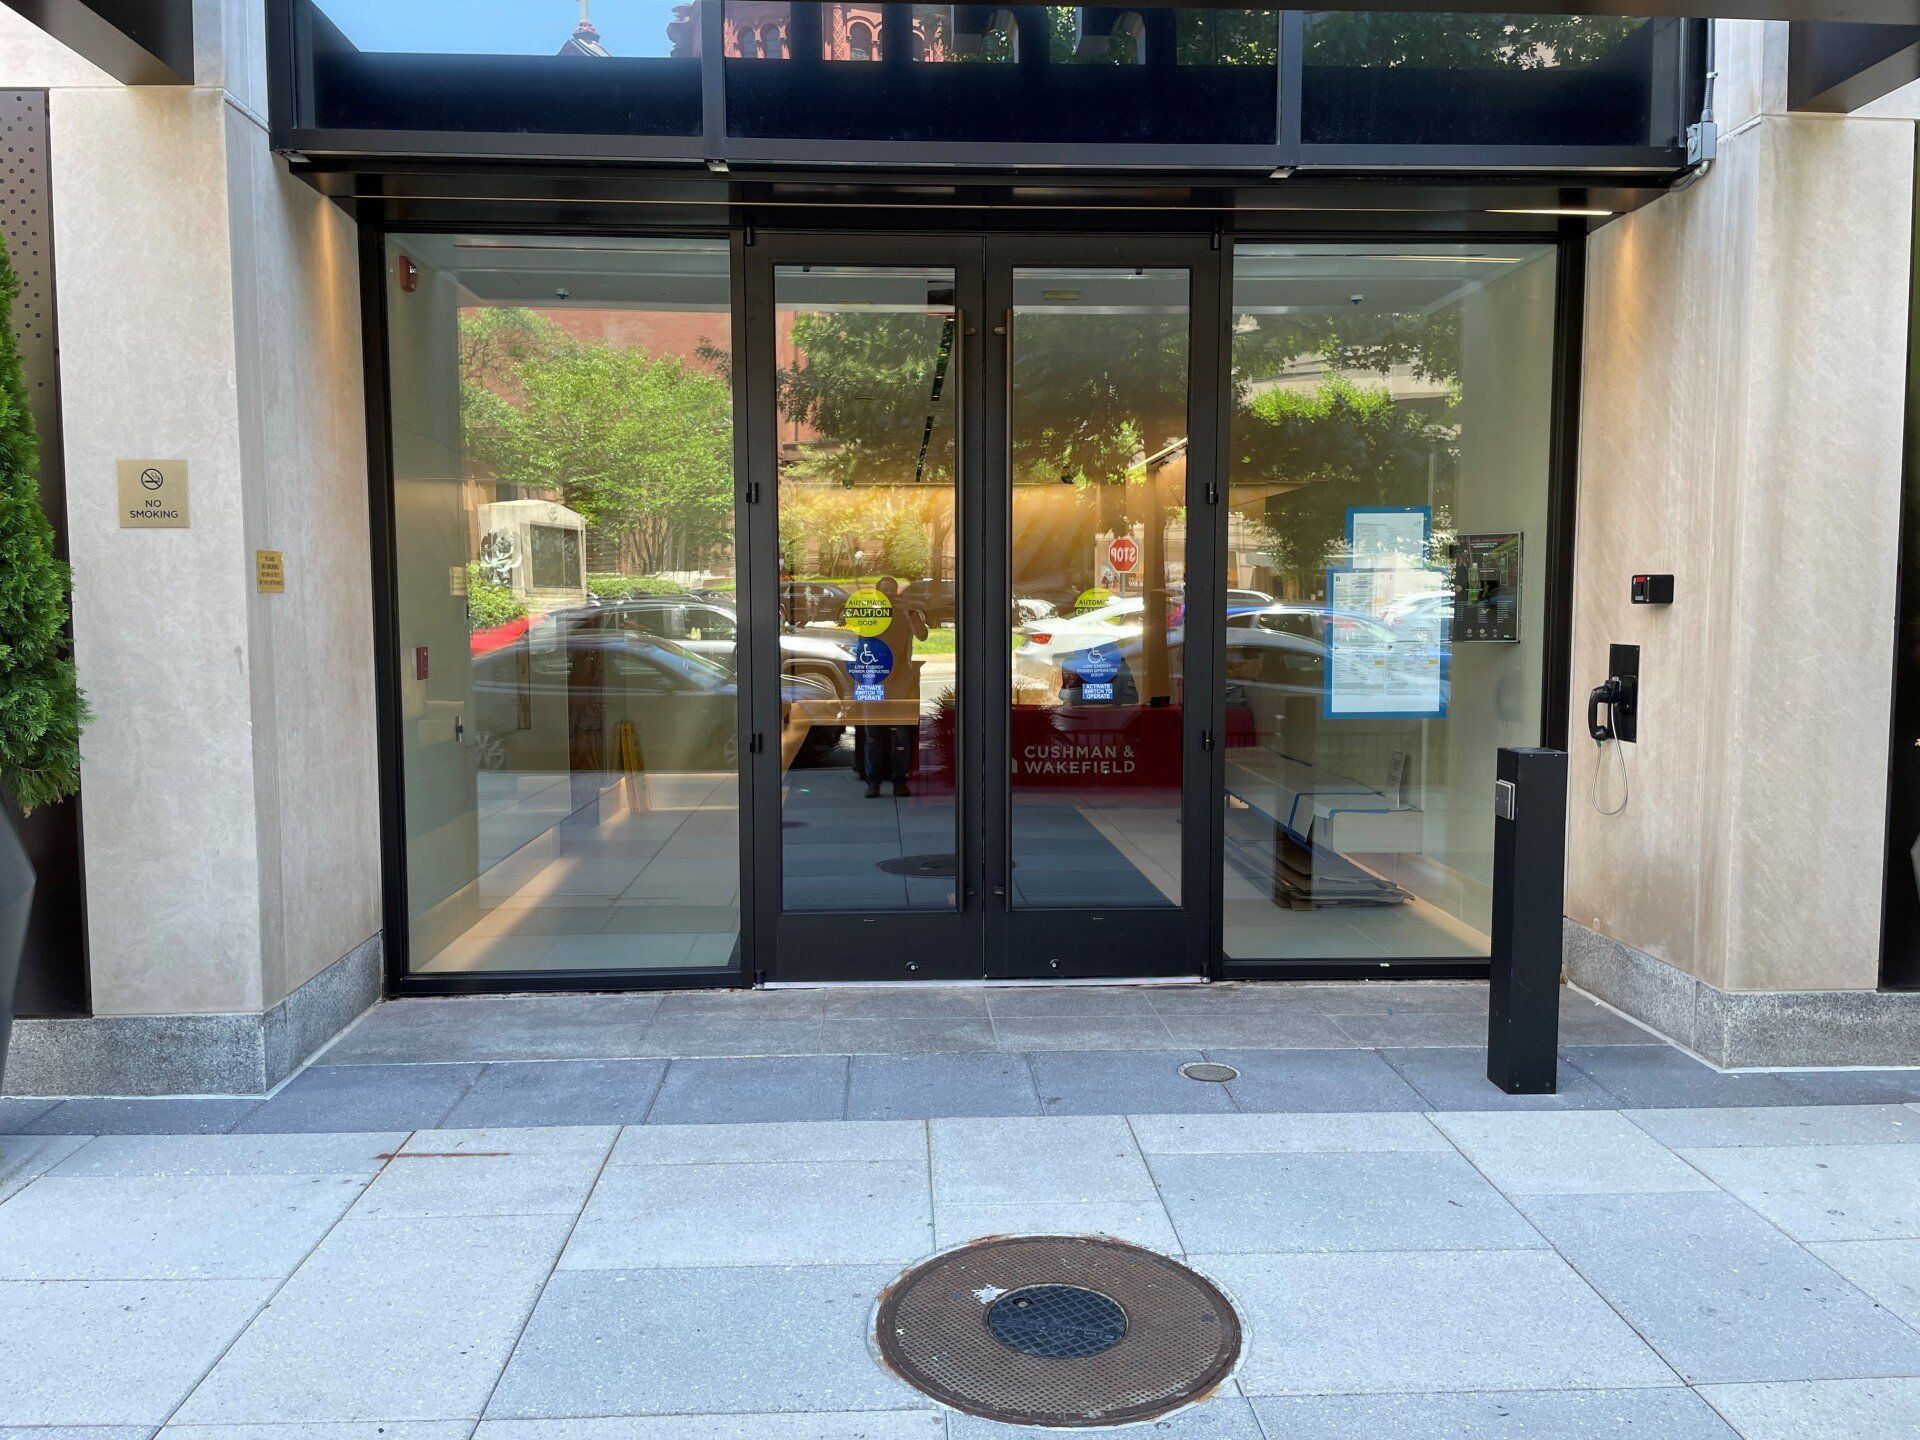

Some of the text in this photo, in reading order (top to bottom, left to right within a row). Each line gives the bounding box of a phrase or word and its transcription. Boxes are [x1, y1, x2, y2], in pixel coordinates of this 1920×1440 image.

[145, 499, 162, 508] NO
[129, 510, 179, 519] SMOKING
[846, 608, 890, 617] CAUTION
[1024, 745, 1135, 759] CUSHMAN &
[1024, 761, 1136, 774] WAKEFIELD
